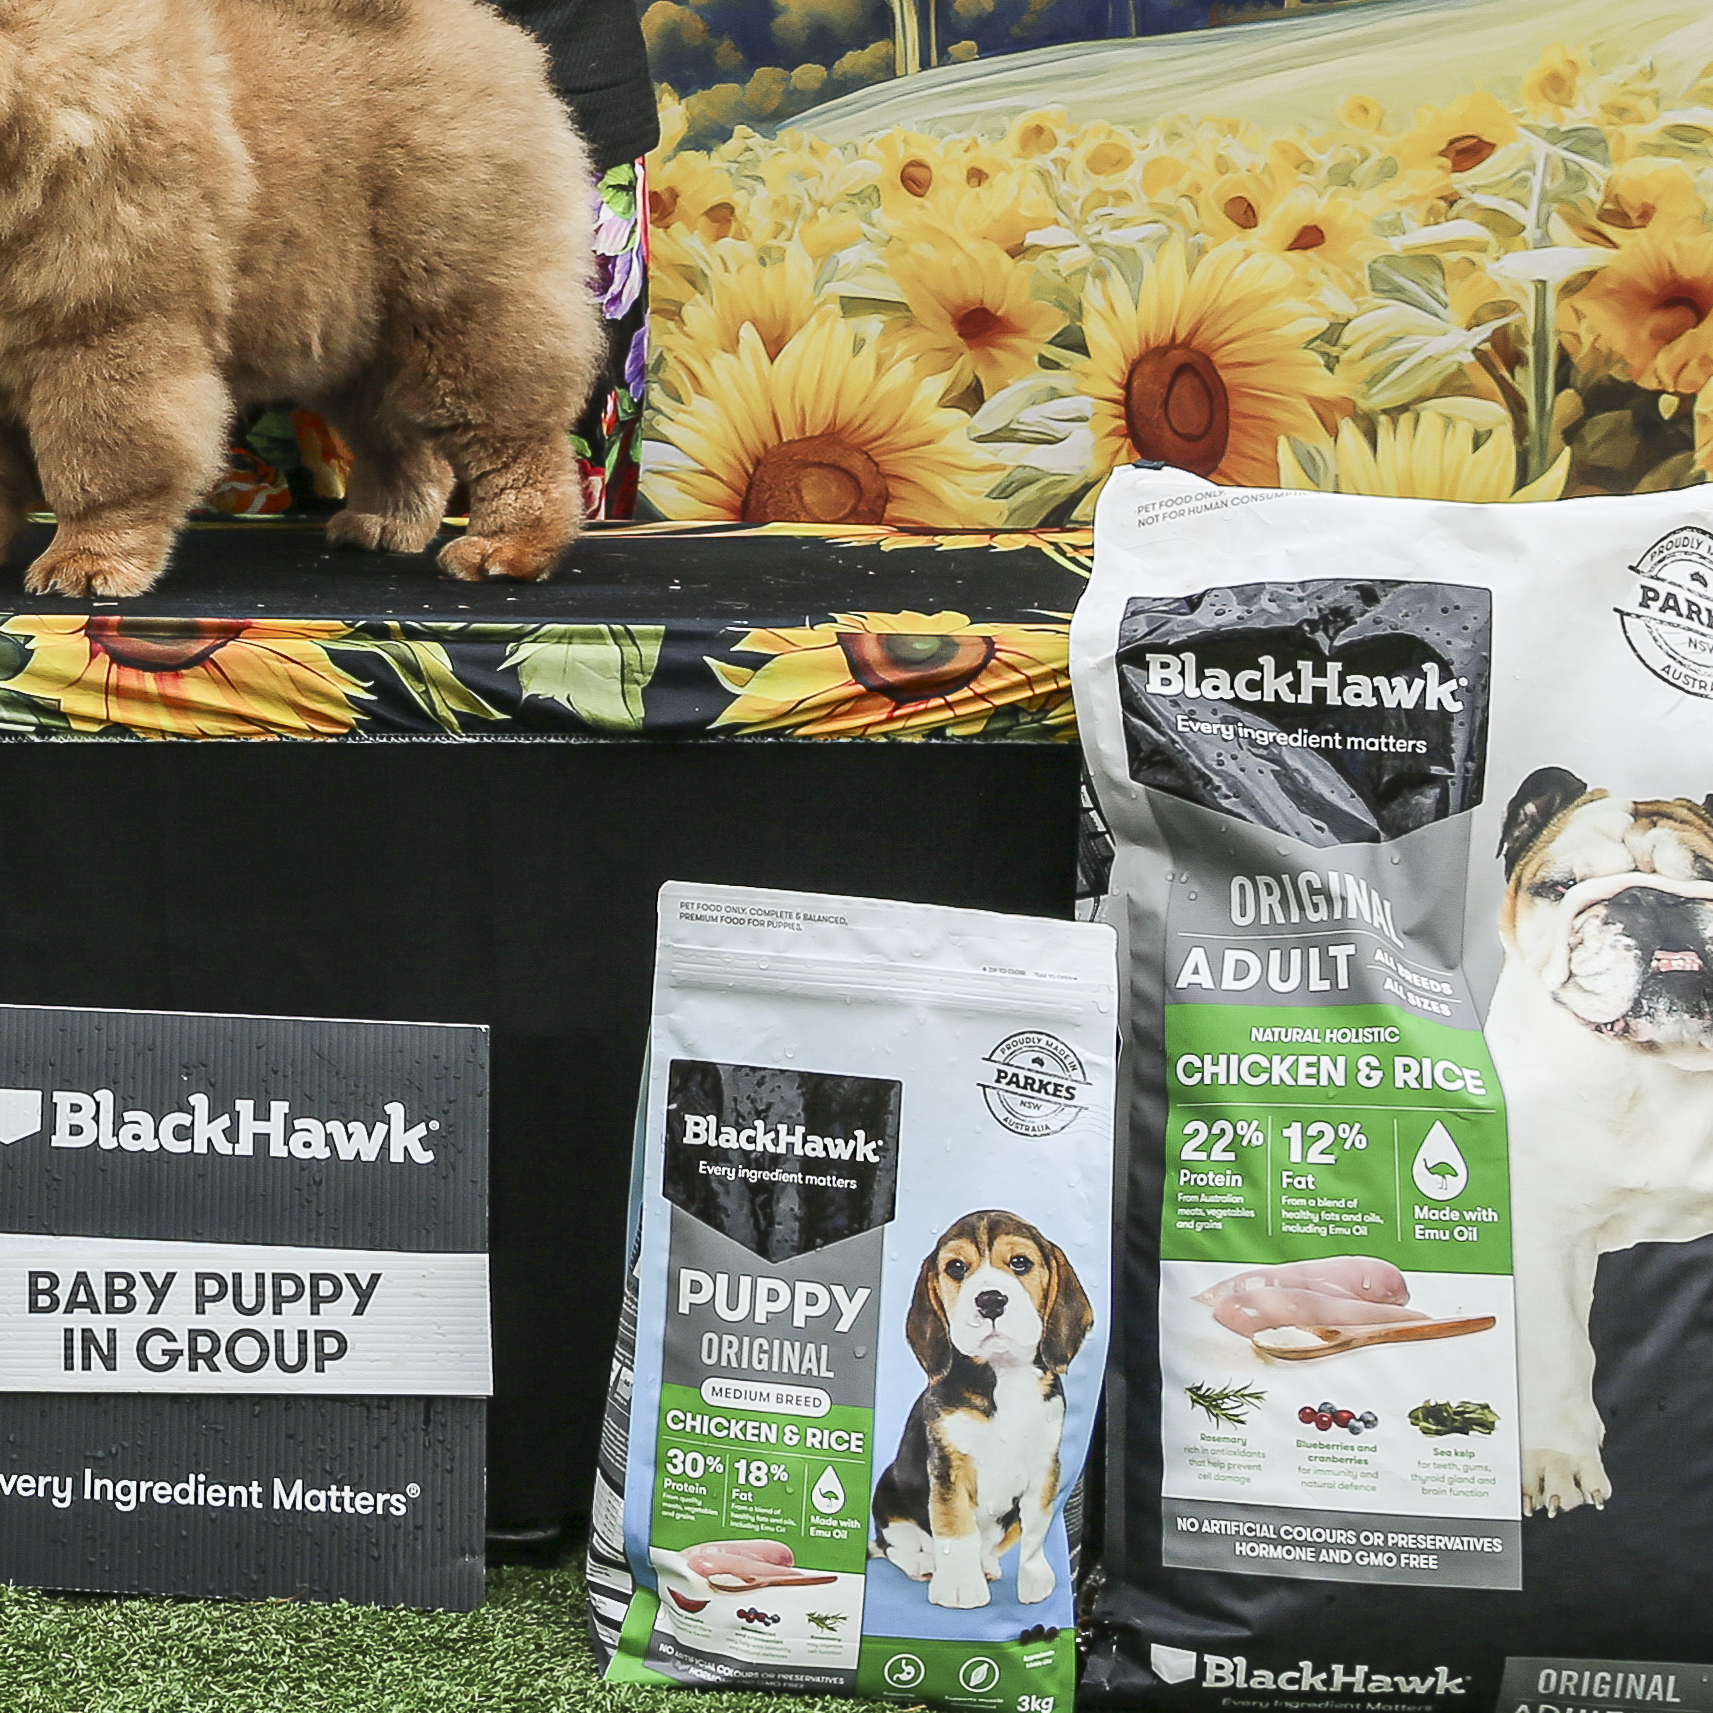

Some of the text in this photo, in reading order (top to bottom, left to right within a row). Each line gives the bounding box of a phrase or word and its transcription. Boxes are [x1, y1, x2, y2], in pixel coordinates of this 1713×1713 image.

[1650, 536, 1703, 561] PROUDLY
[1176, 715, 1427, 754] Every ingredient matters
[679, 902, 694, 910] PET
[696, 903, 722, 912] FOOD
[749, 908, 793, 919] COMPLETE
[679, 913, 718, 923] PREMIUM
[720, 916, 745, 925] FOOD
[748, 918, 766, 928] FOR
[1230, 870, 1404, 949] ORIGINAL
[1175, 944, 1356, 992] ADULT
[1374, 948, 1453, 995] ALL BREEDS
[1384, 977, 1451, 1017] ALL SIZES
[1250, 1026, 1400, 1044] NATURAL HOLISTIC
[1000, 1037, 1078, 1071] PROUDLY MADE IN
[995, 1069, 1076, 1100] PARKES
[1176, 1053, 1487, 1096] CHICKEN & RICE
[1019, 1100, 1043, 1111] NSW
[1002, 1116, 1051, 1132] AUSTRALIA
[1180, 1119, 1367, 1165] 22% 12%
[699, 1161, 857, 1189] Every ingredient matters
[1179, 1170, 1316, 1190] Protein Fat
[1414, 1205, 1499, 1222] Made with
[1414, 1225, 1477, 1242] Emu Oil
[28, 1270, 382, 1316] BABY PUPPY
[678, 1268, 871, 1333] PUPPY
[63, 1327, 348, 1374] IN GROUP
[701, 1332, 835, 1379] ORIGINAL
[711, 1386, 822, 1408] MEDIUM BREED
[666, 1410, 864, 1453] CHICKEN & RICE
[1200, 1433, 1246, 1446] Rosemary
[665, 1447, 788, 1487] 30% 18%
[1433, 1447, 1475, 1460] Sea kelp
[84, 1469, 263, 1511] Ingredient
[664, 1478, 753, 1502] Protein Fat
[1177, 1517, 1502, 1553] NO ARTIFICIAL COLOURS OR PRESERVATIVES
[1235, 1541, 1438, 1569] HORMONE AND GMO FREE
[1537, 1668, 1681, 1703] ORIGINAL
[1017, 1695, 1054, 1713] 3kg
